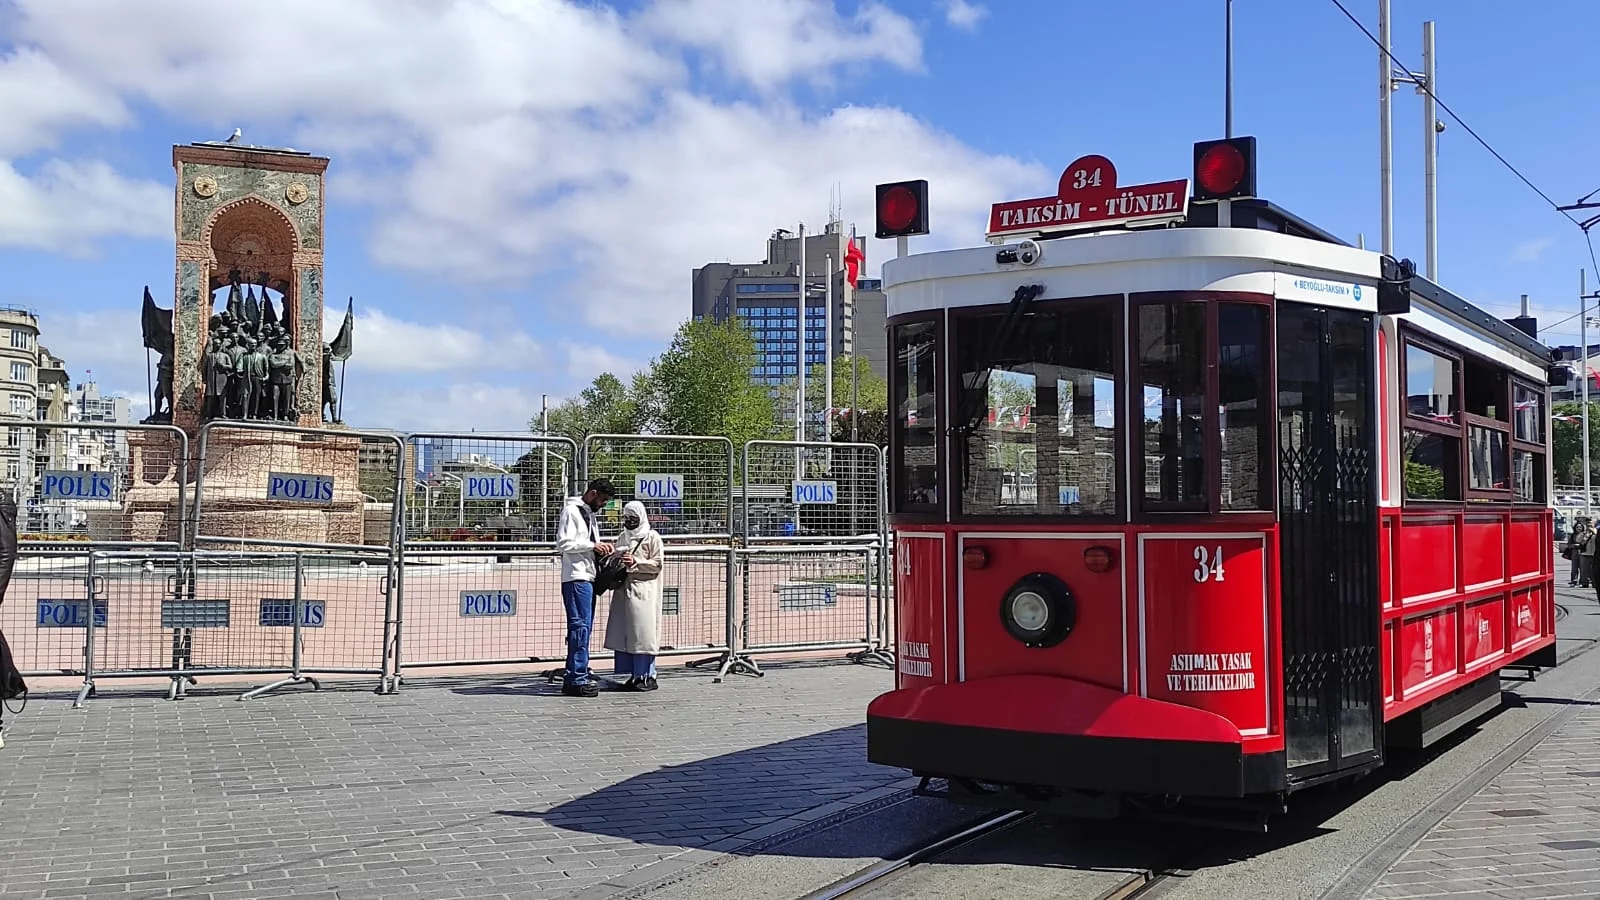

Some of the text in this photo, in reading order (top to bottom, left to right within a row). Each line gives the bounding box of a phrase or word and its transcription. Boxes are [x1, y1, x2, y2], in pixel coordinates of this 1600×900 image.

[1073, 168, 1102, 189] 34
[1000, 200, 1081, 226] TAKSİM
[1106, 192, 1178, 216] TÜNEL
[45, 473, 110, 497] POLİS
[271, 477, 333, 501] POLİS
[468, 474, 514, 497] POLİS
[640, 476, 679, 498] POLİS
[796, 482, 833, 502] POLİS
[1193, 545, 1224, 582] 34
[464, 590, 511, 615] POLİS
[1220, 652, 1253, 670] YASAK
[1167, 672, 1256, 691] VE TEHLIKELIDIR
